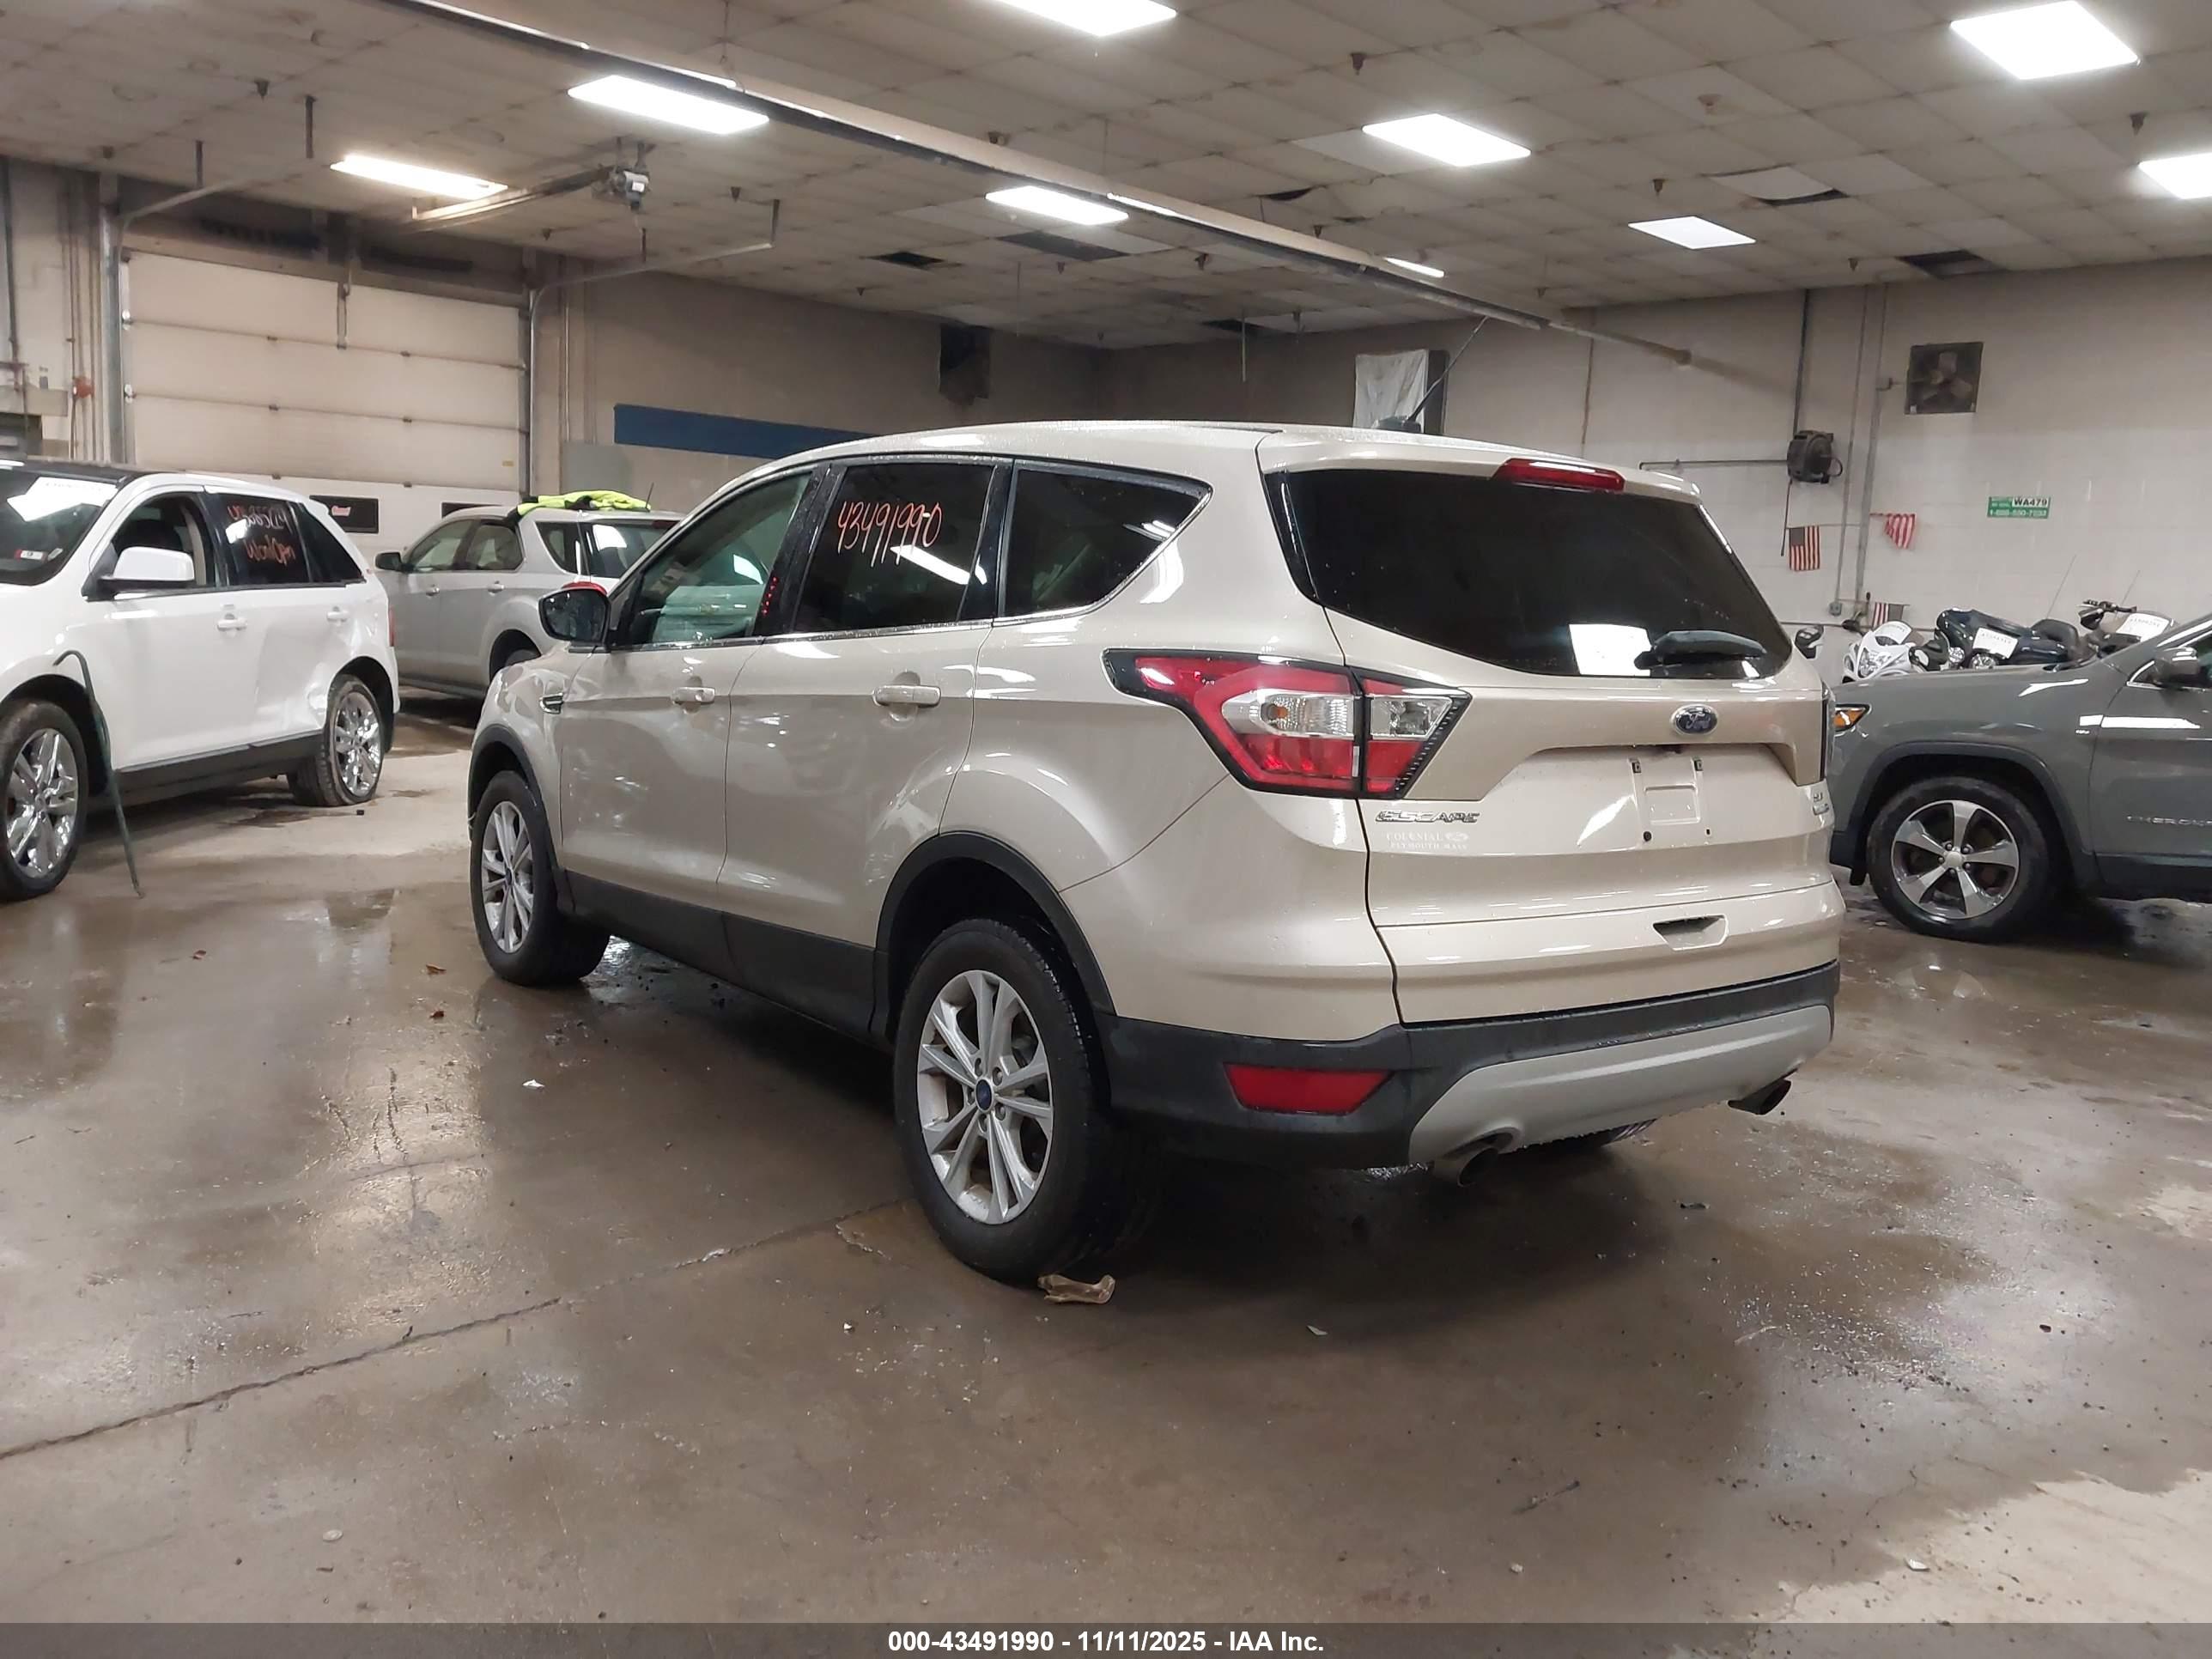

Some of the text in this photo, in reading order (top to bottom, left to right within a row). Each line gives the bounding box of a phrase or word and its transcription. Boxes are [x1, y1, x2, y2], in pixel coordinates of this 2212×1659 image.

[2014, 497, 2048, 506] WA479
[838, 501, 942, 568] 43491990
[1376, 810, 1480, 823] ESCAPE
